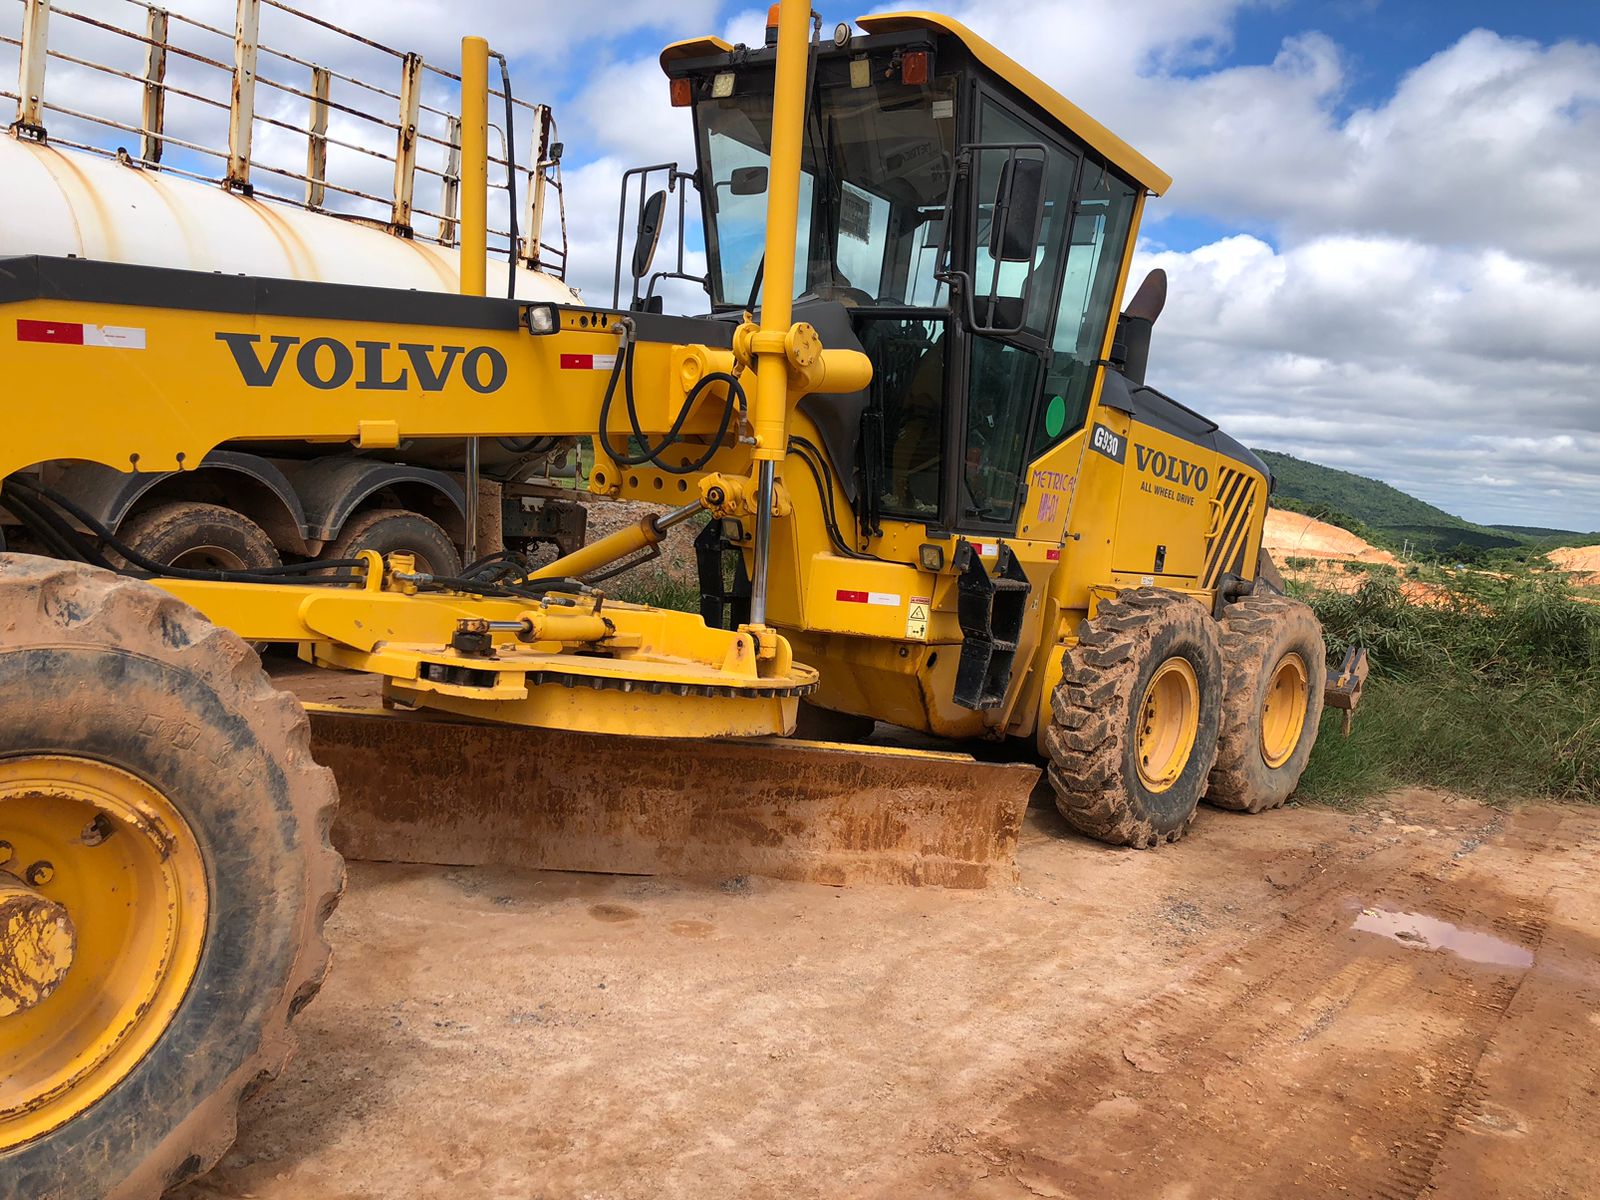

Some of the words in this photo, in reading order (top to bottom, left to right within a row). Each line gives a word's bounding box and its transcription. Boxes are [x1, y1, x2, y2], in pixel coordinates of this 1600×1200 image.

[215, 332, 507, 394] VOLVO
[1094, 427, 1119, 457] G930
[1134, 443, 1209, 492] VOLVO
[1140, 481, 1152, 494] ALL
[1154, 485, 1175, 501] WHEEL
[1176, 492, 1195, 506] DRIVE
